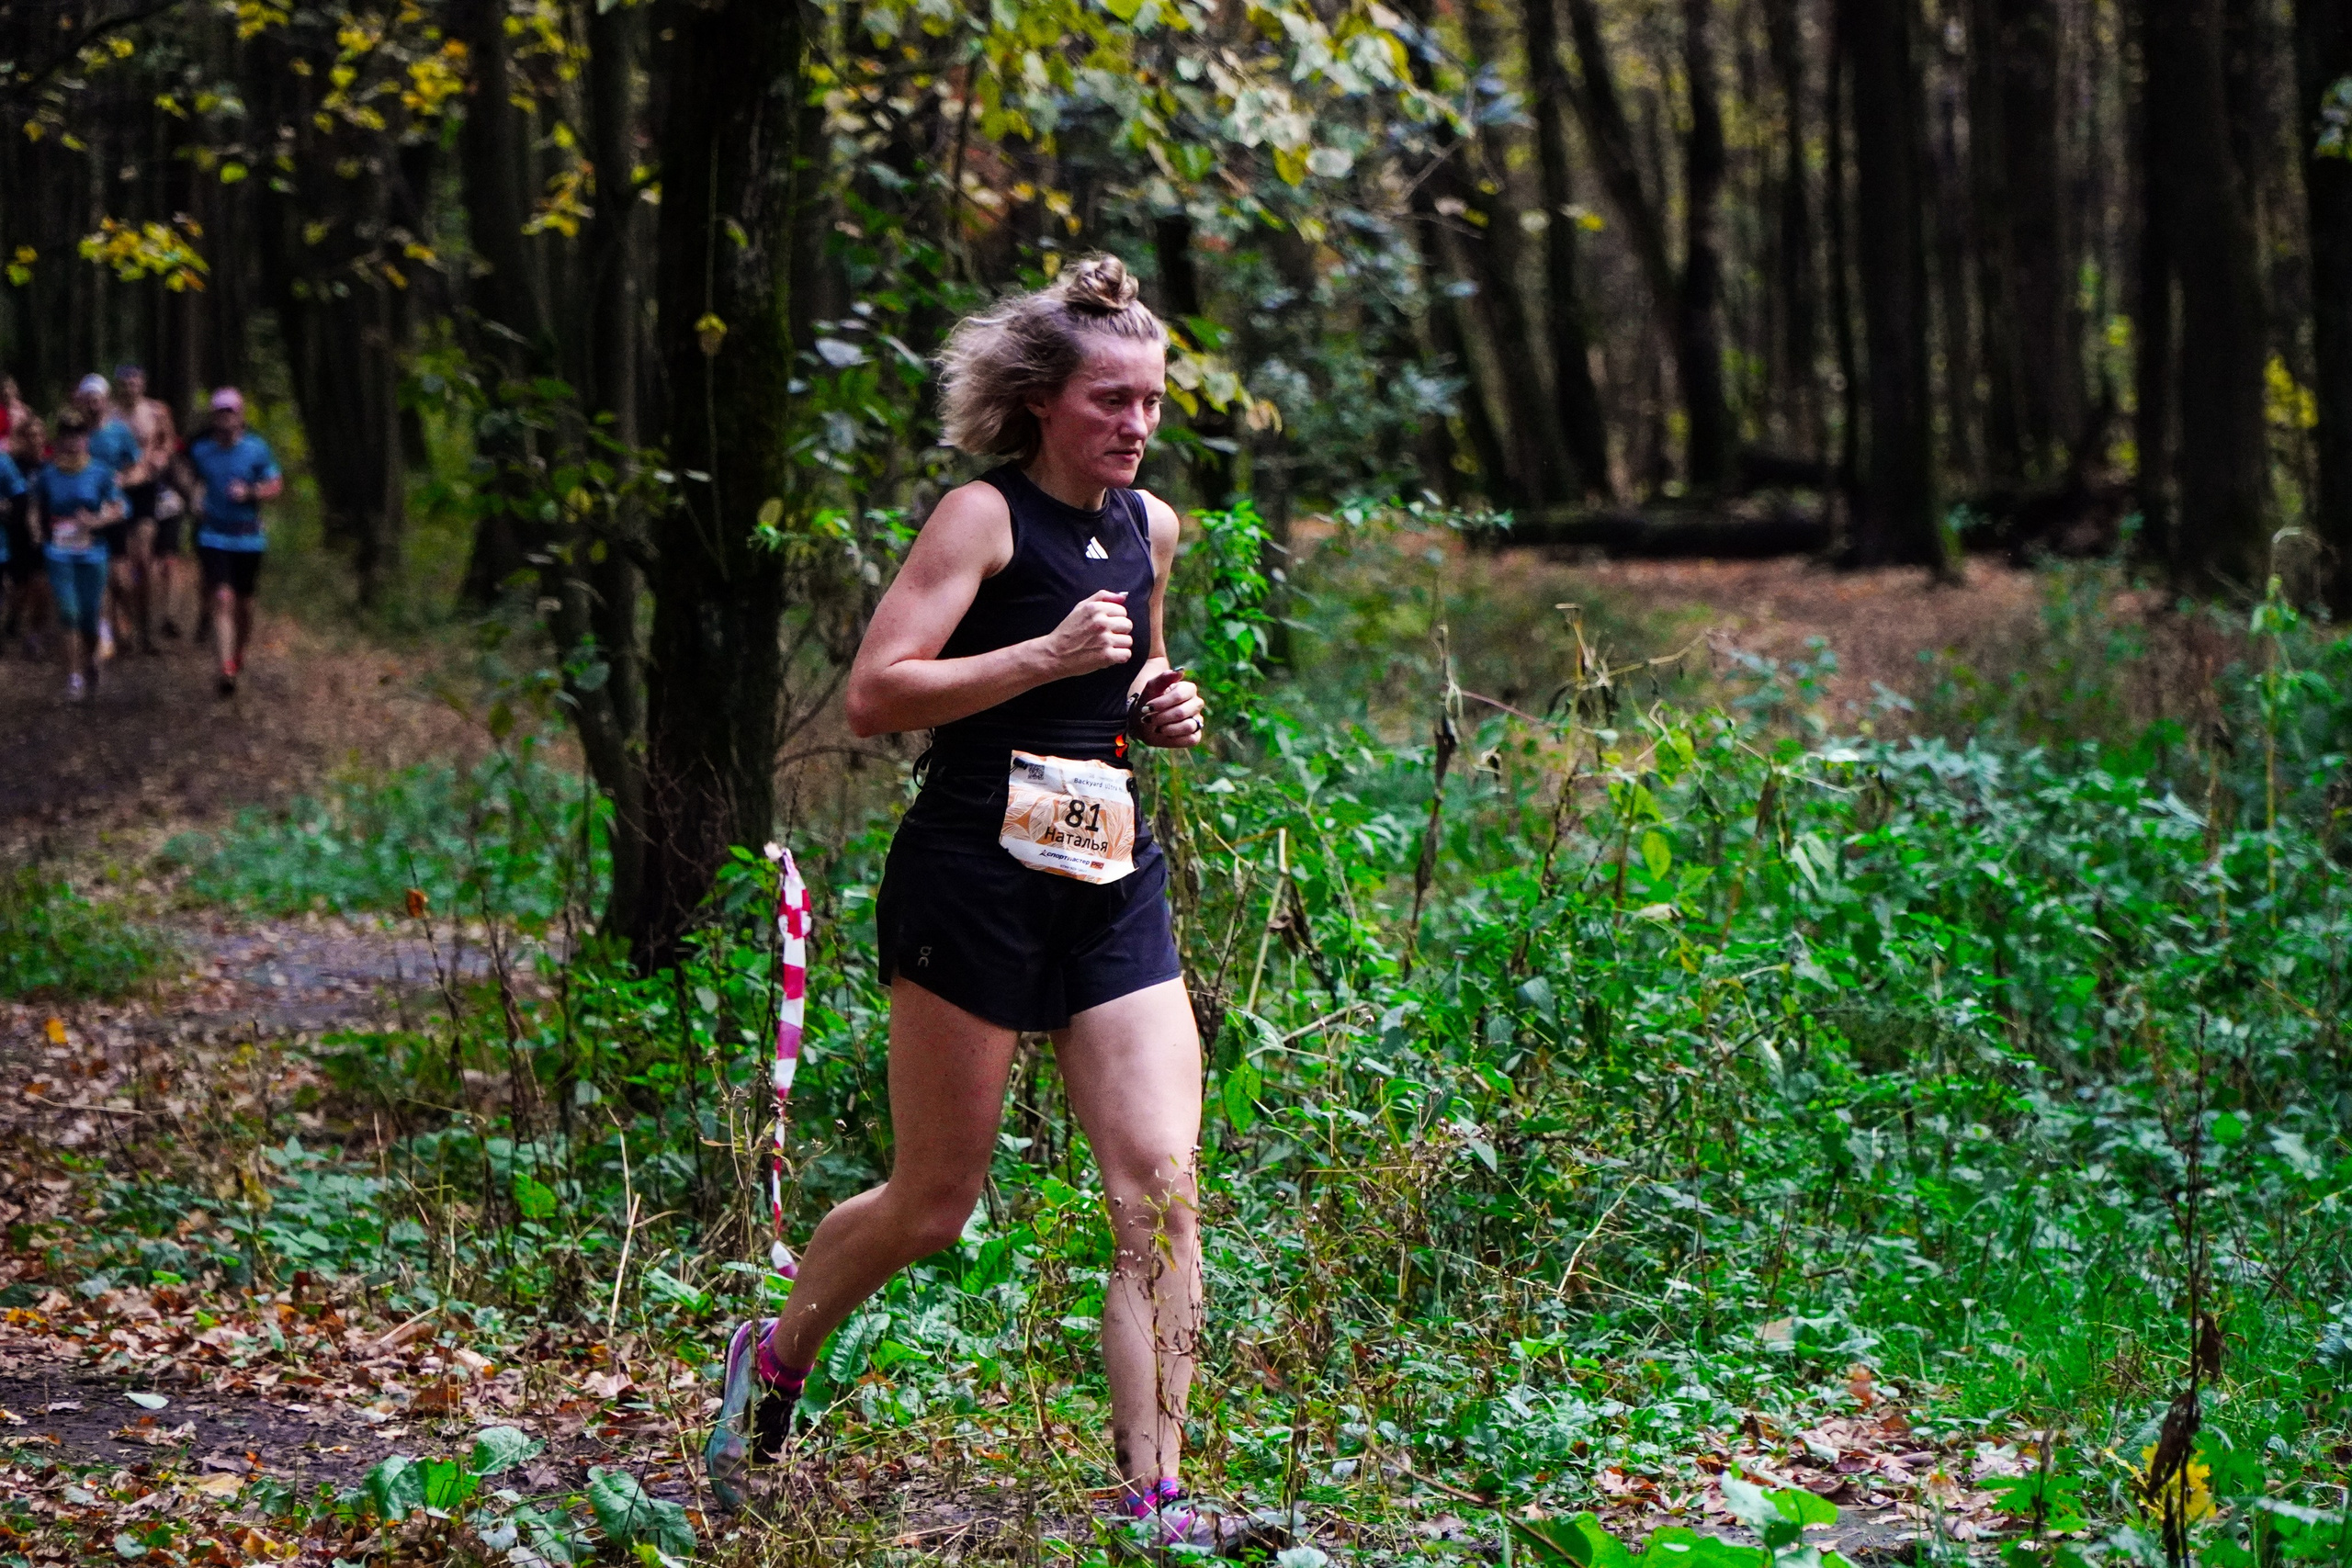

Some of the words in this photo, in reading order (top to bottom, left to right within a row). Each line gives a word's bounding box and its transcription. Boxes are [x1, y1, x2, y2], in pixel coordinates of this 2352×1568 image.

[1073, 777, 1103, 788] Backyard
[1065, 799, 1101, 833] 81
[1045, 826, 1109, 853] Наталья
